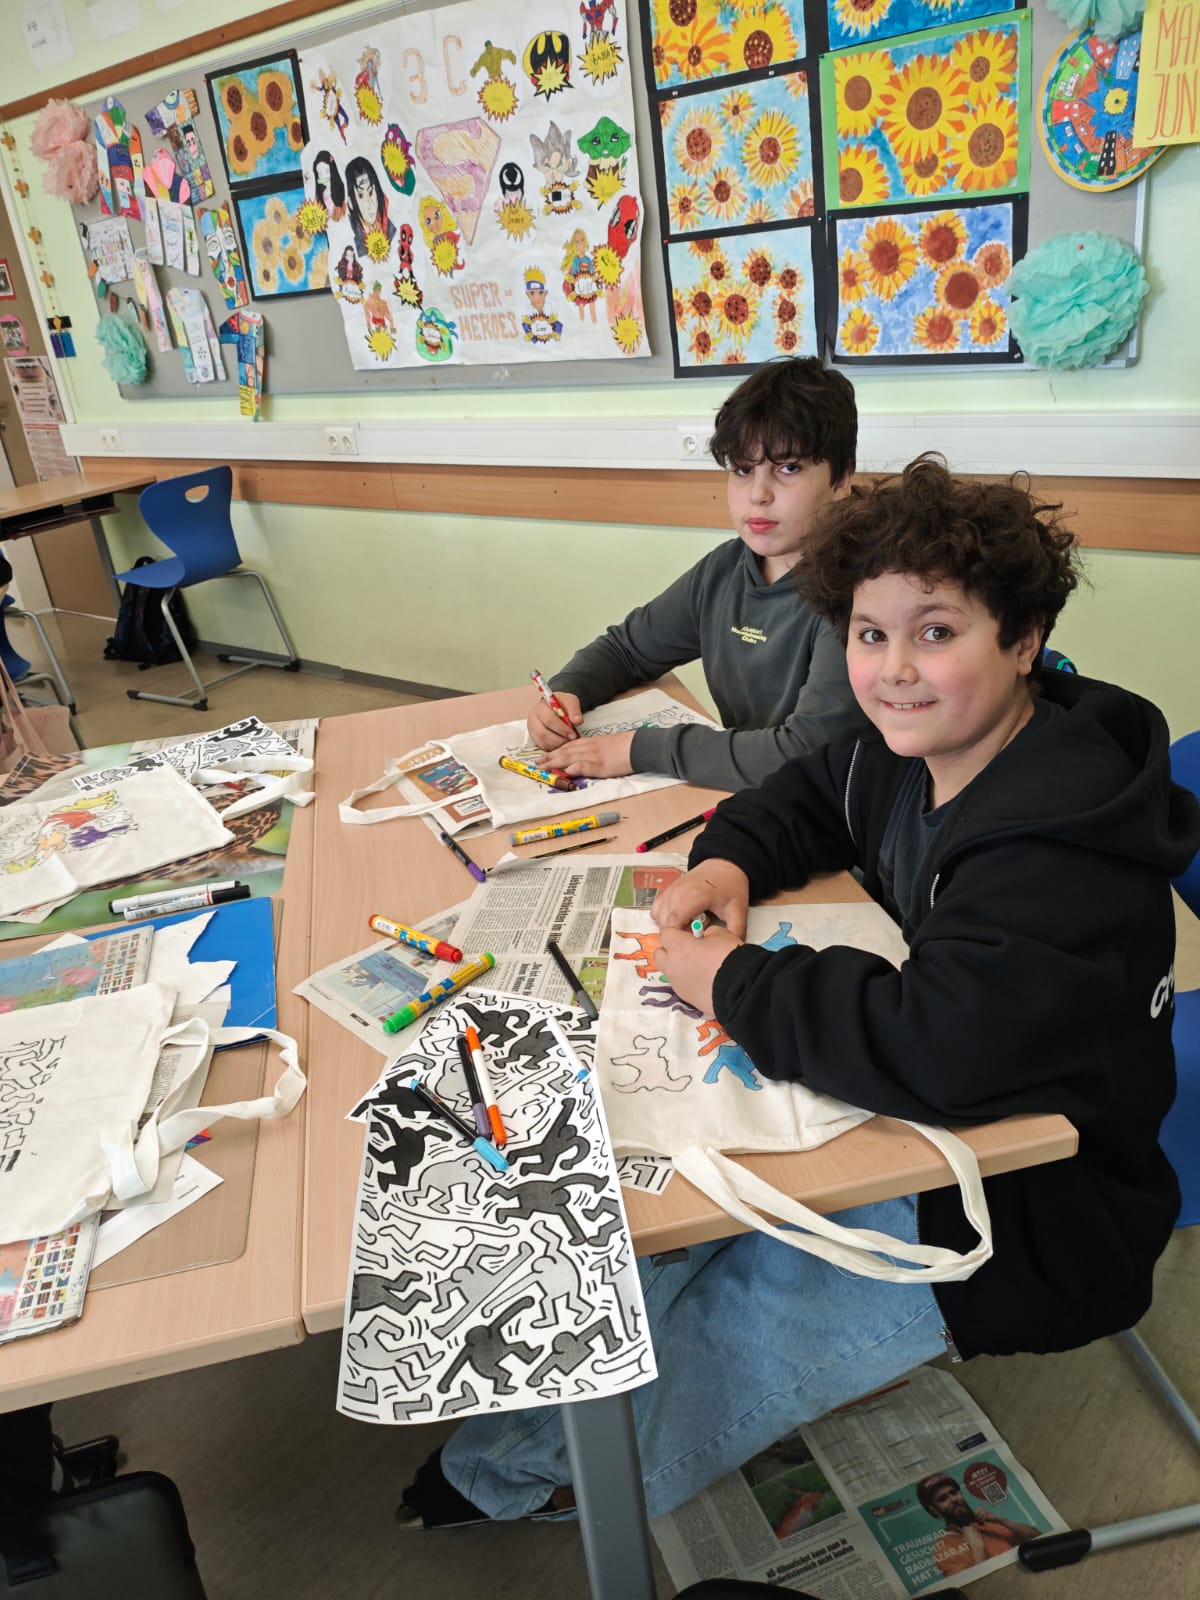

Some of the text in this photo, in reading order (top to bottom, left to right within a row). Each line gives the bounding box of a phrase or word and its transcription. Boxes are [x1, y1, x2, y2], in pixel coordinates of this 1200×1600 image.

[402, 34, 468, 105] 3 C
[458, 312, 520, 341] HEROES
[899, 1540, 946, 1565] GESUCHT?
